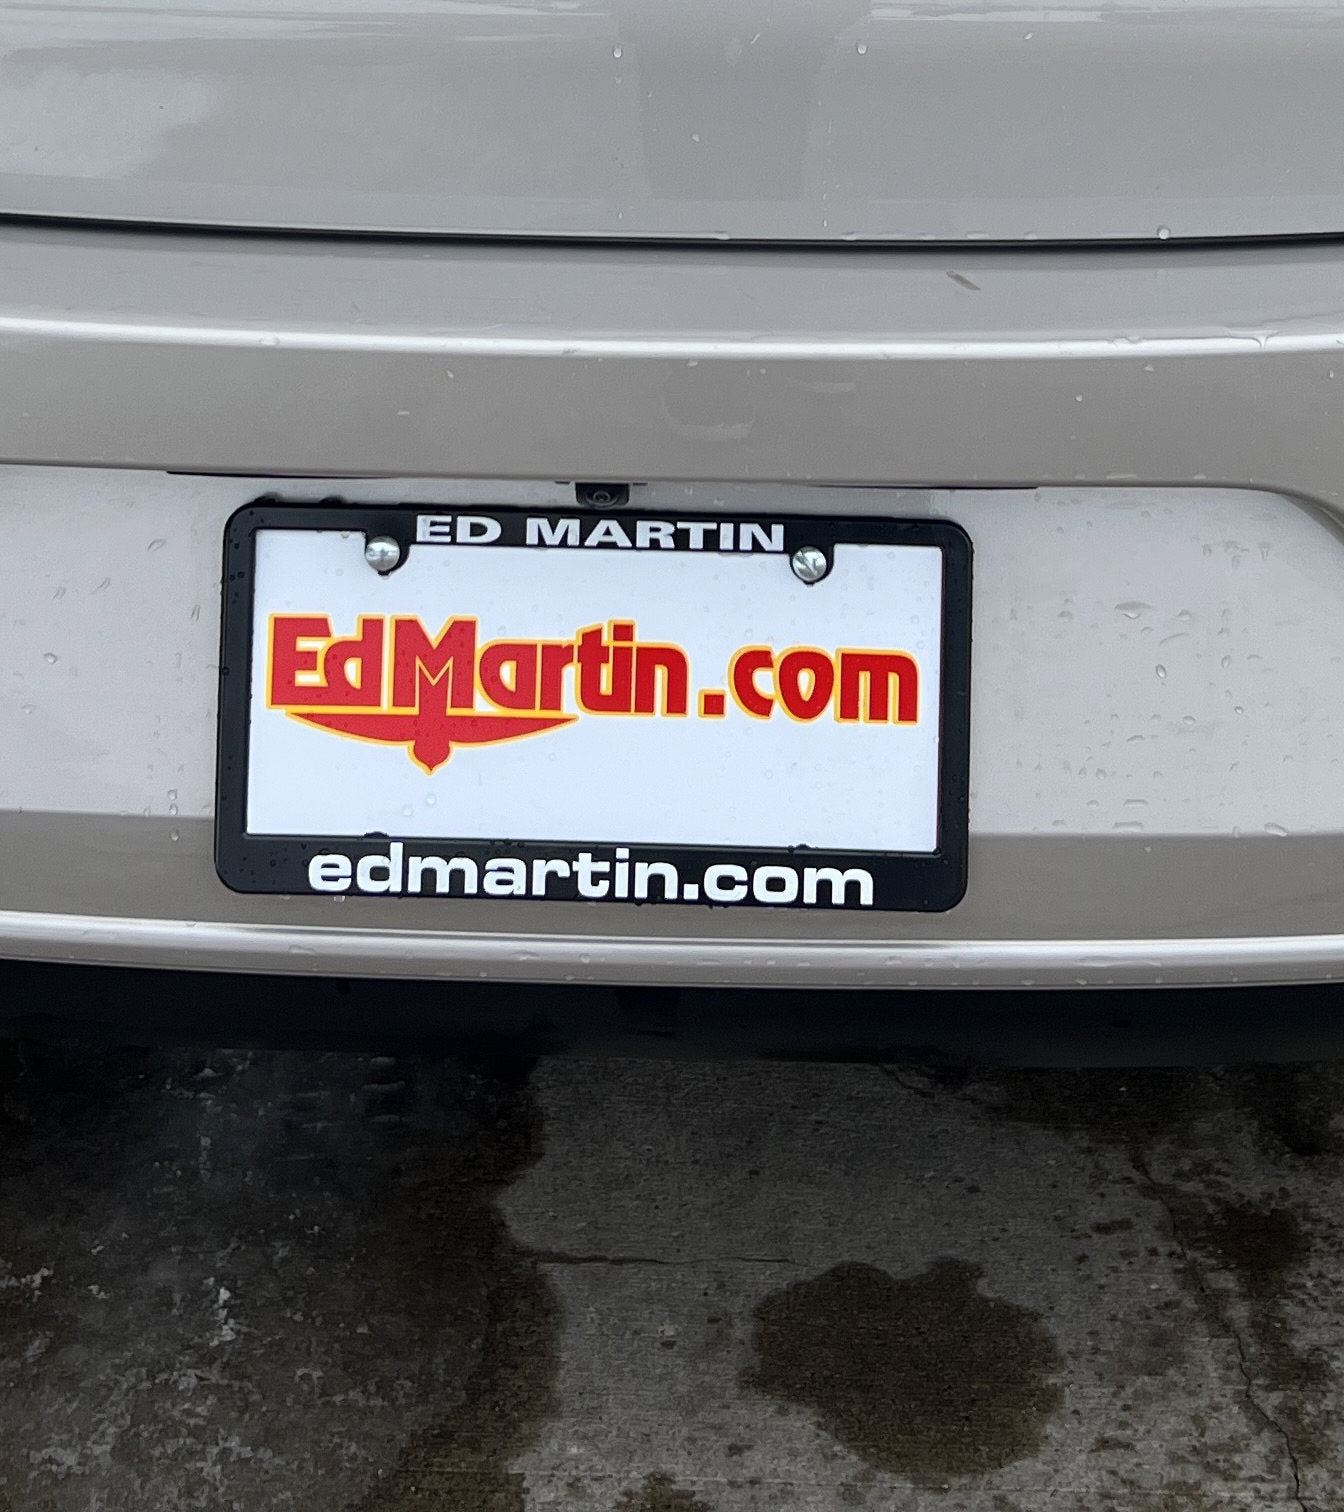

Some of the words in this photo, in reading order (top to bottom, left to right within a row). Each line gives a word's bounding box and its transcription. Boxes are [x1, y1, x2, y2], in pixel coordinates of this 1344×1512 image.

[415, 515, 503, 545] ED
[525, 518, 786, 552] MARTIN
[308, 842, 874, 905] edmartin.com
